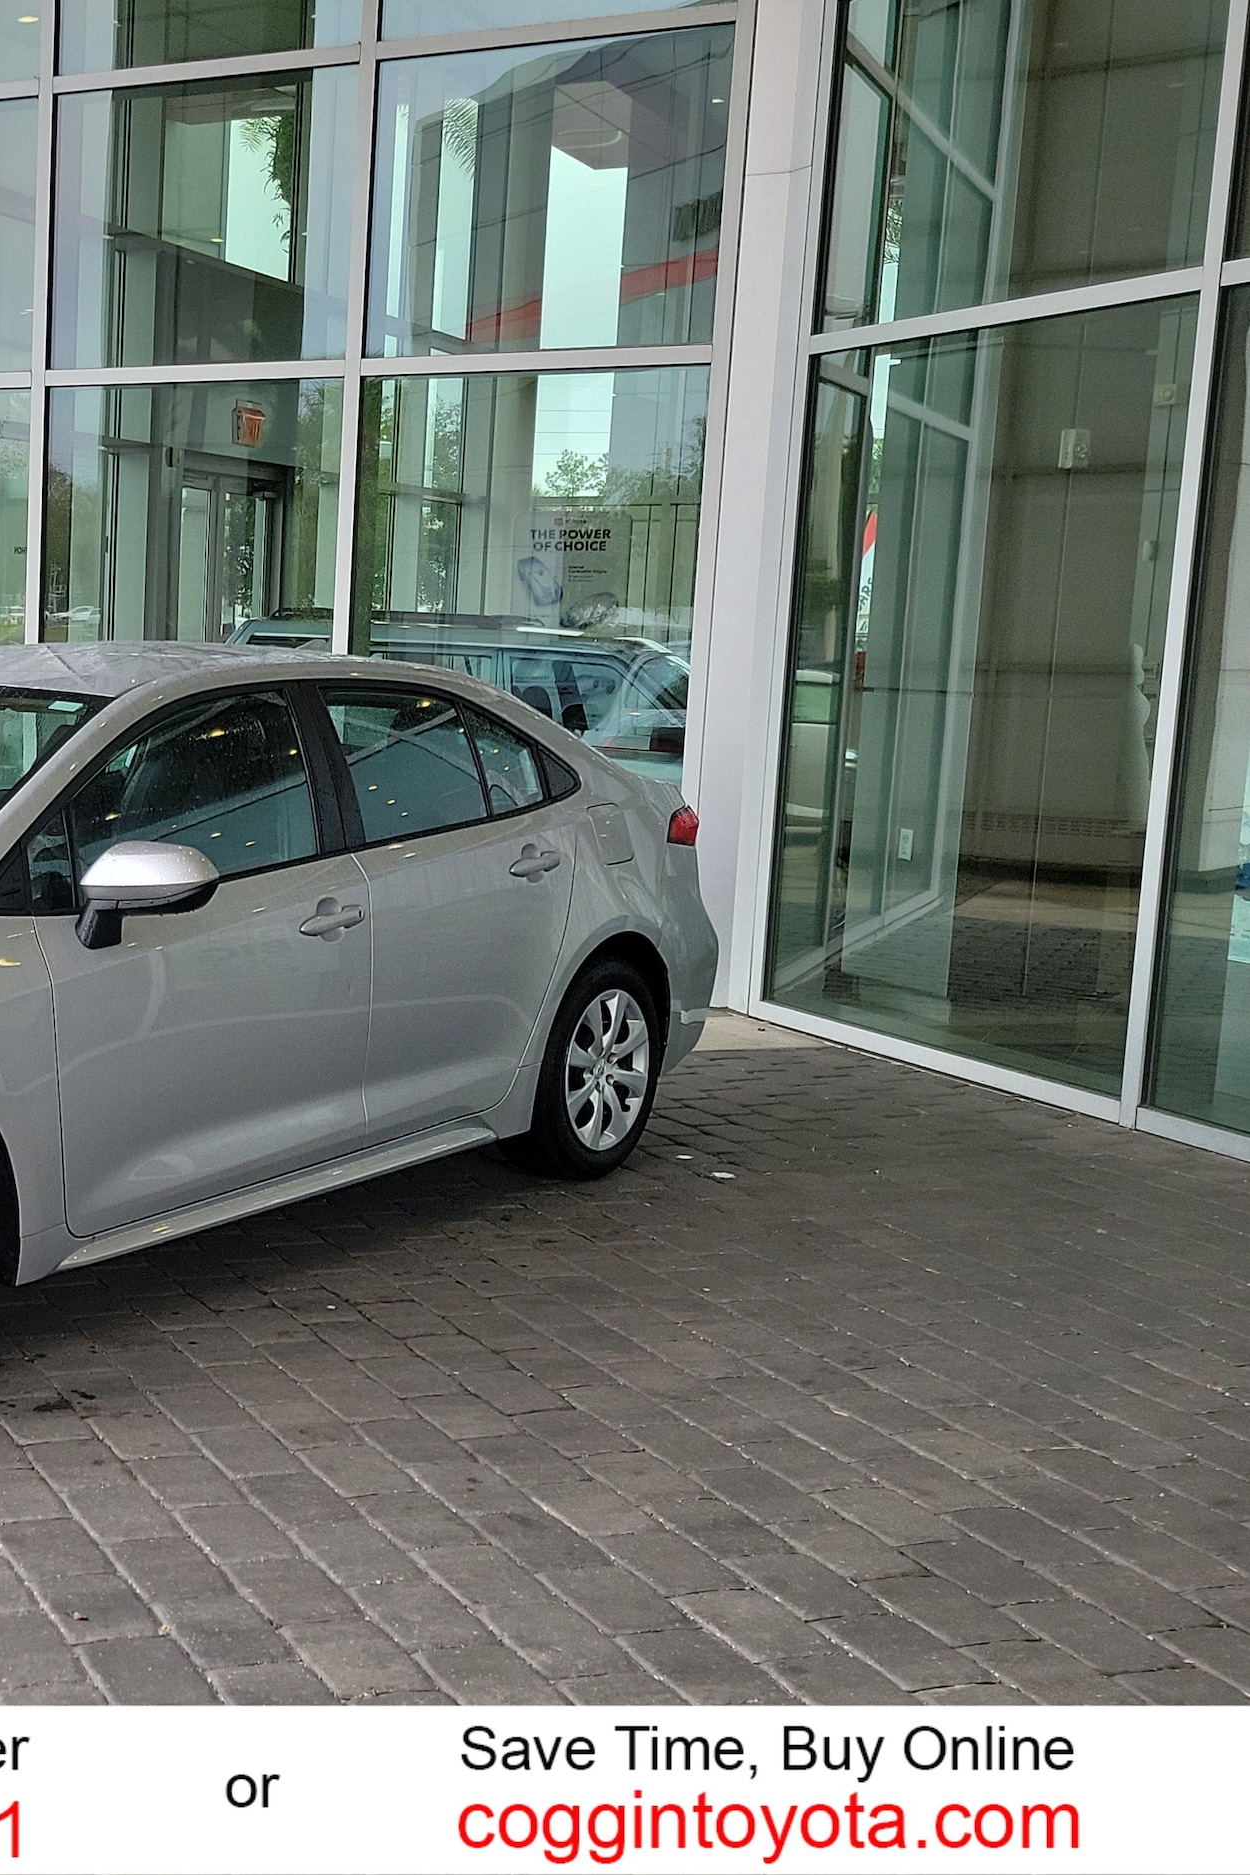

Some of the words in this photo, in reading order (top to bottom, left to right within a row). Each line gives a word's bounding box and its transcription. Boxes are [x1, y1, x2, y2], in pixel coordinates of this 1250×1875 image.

[530, 529, 556, 540] THE
[559, 529, 611, 539] POWER
[533, 541, 552, 551] OF
[554, 541, 607, 551] CHOICE
